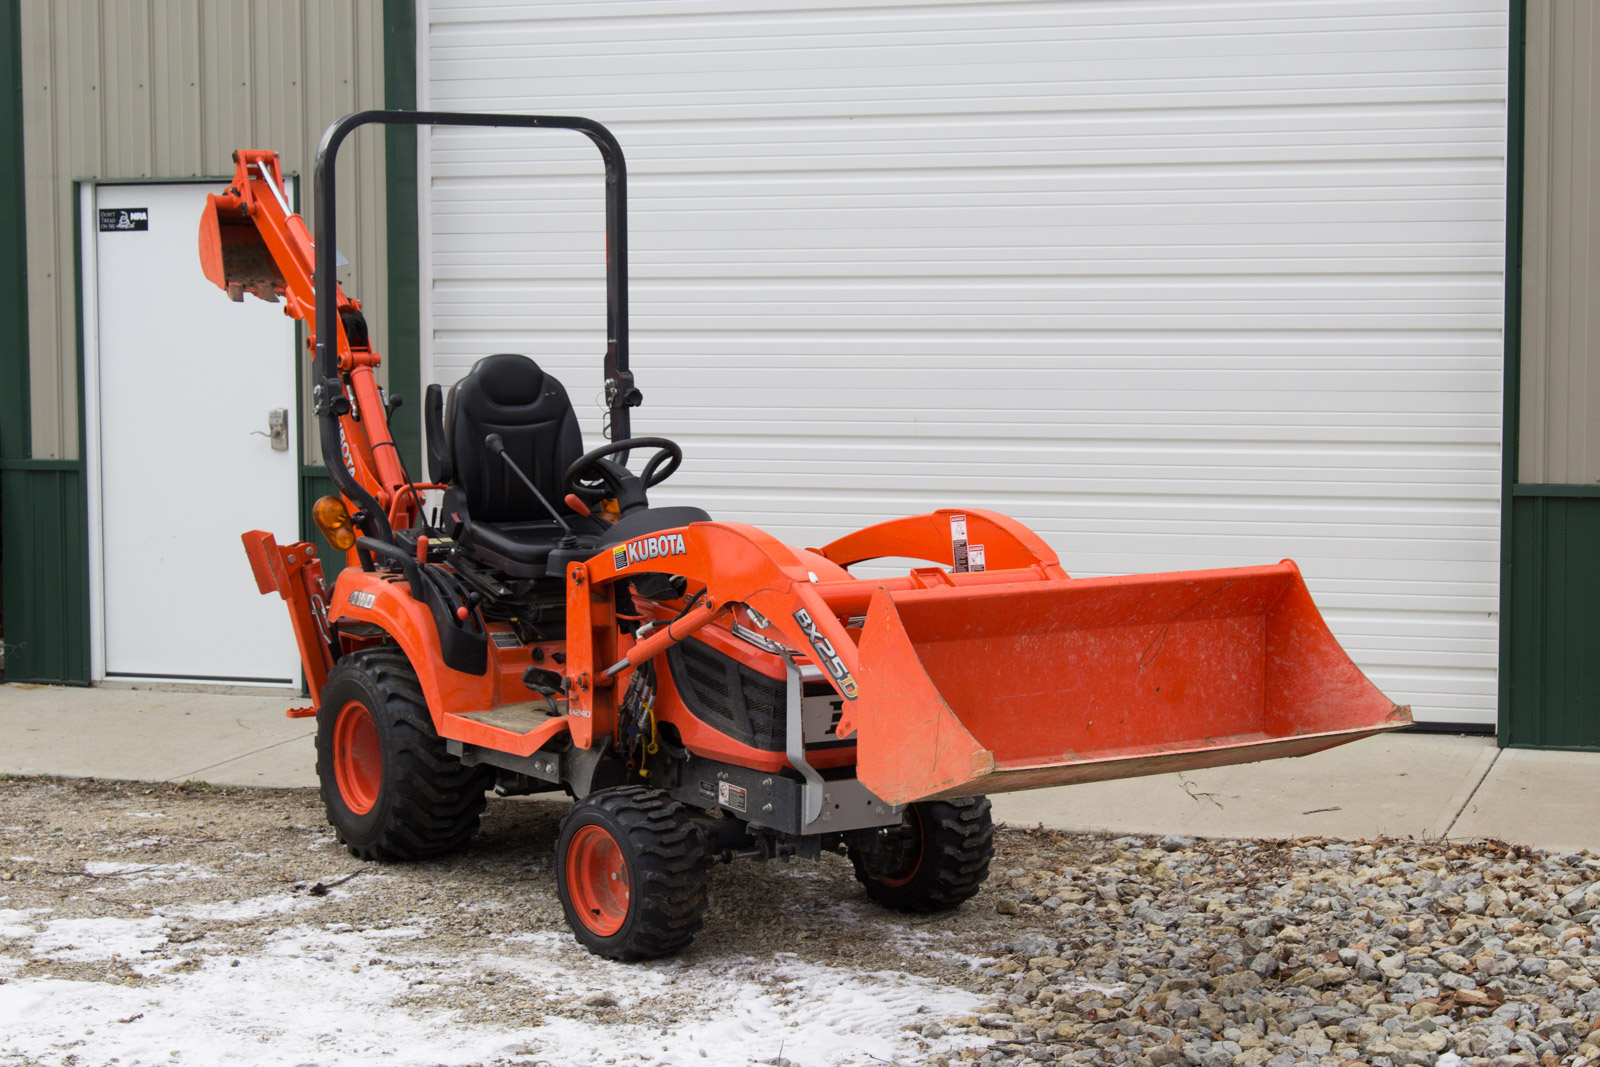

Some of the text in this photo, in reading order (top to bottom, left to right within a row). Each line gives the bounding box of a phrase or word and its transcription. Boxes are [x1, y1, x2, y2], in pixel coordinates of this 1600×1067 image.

[130, 212, 147, 220] NRA
[339, 422, 355, 478] BOTA
[628, 533, 687, 564] KUBOTA
[347, 590, 376, 610] 4WD
[792, 608, 858, 701] BX25D
